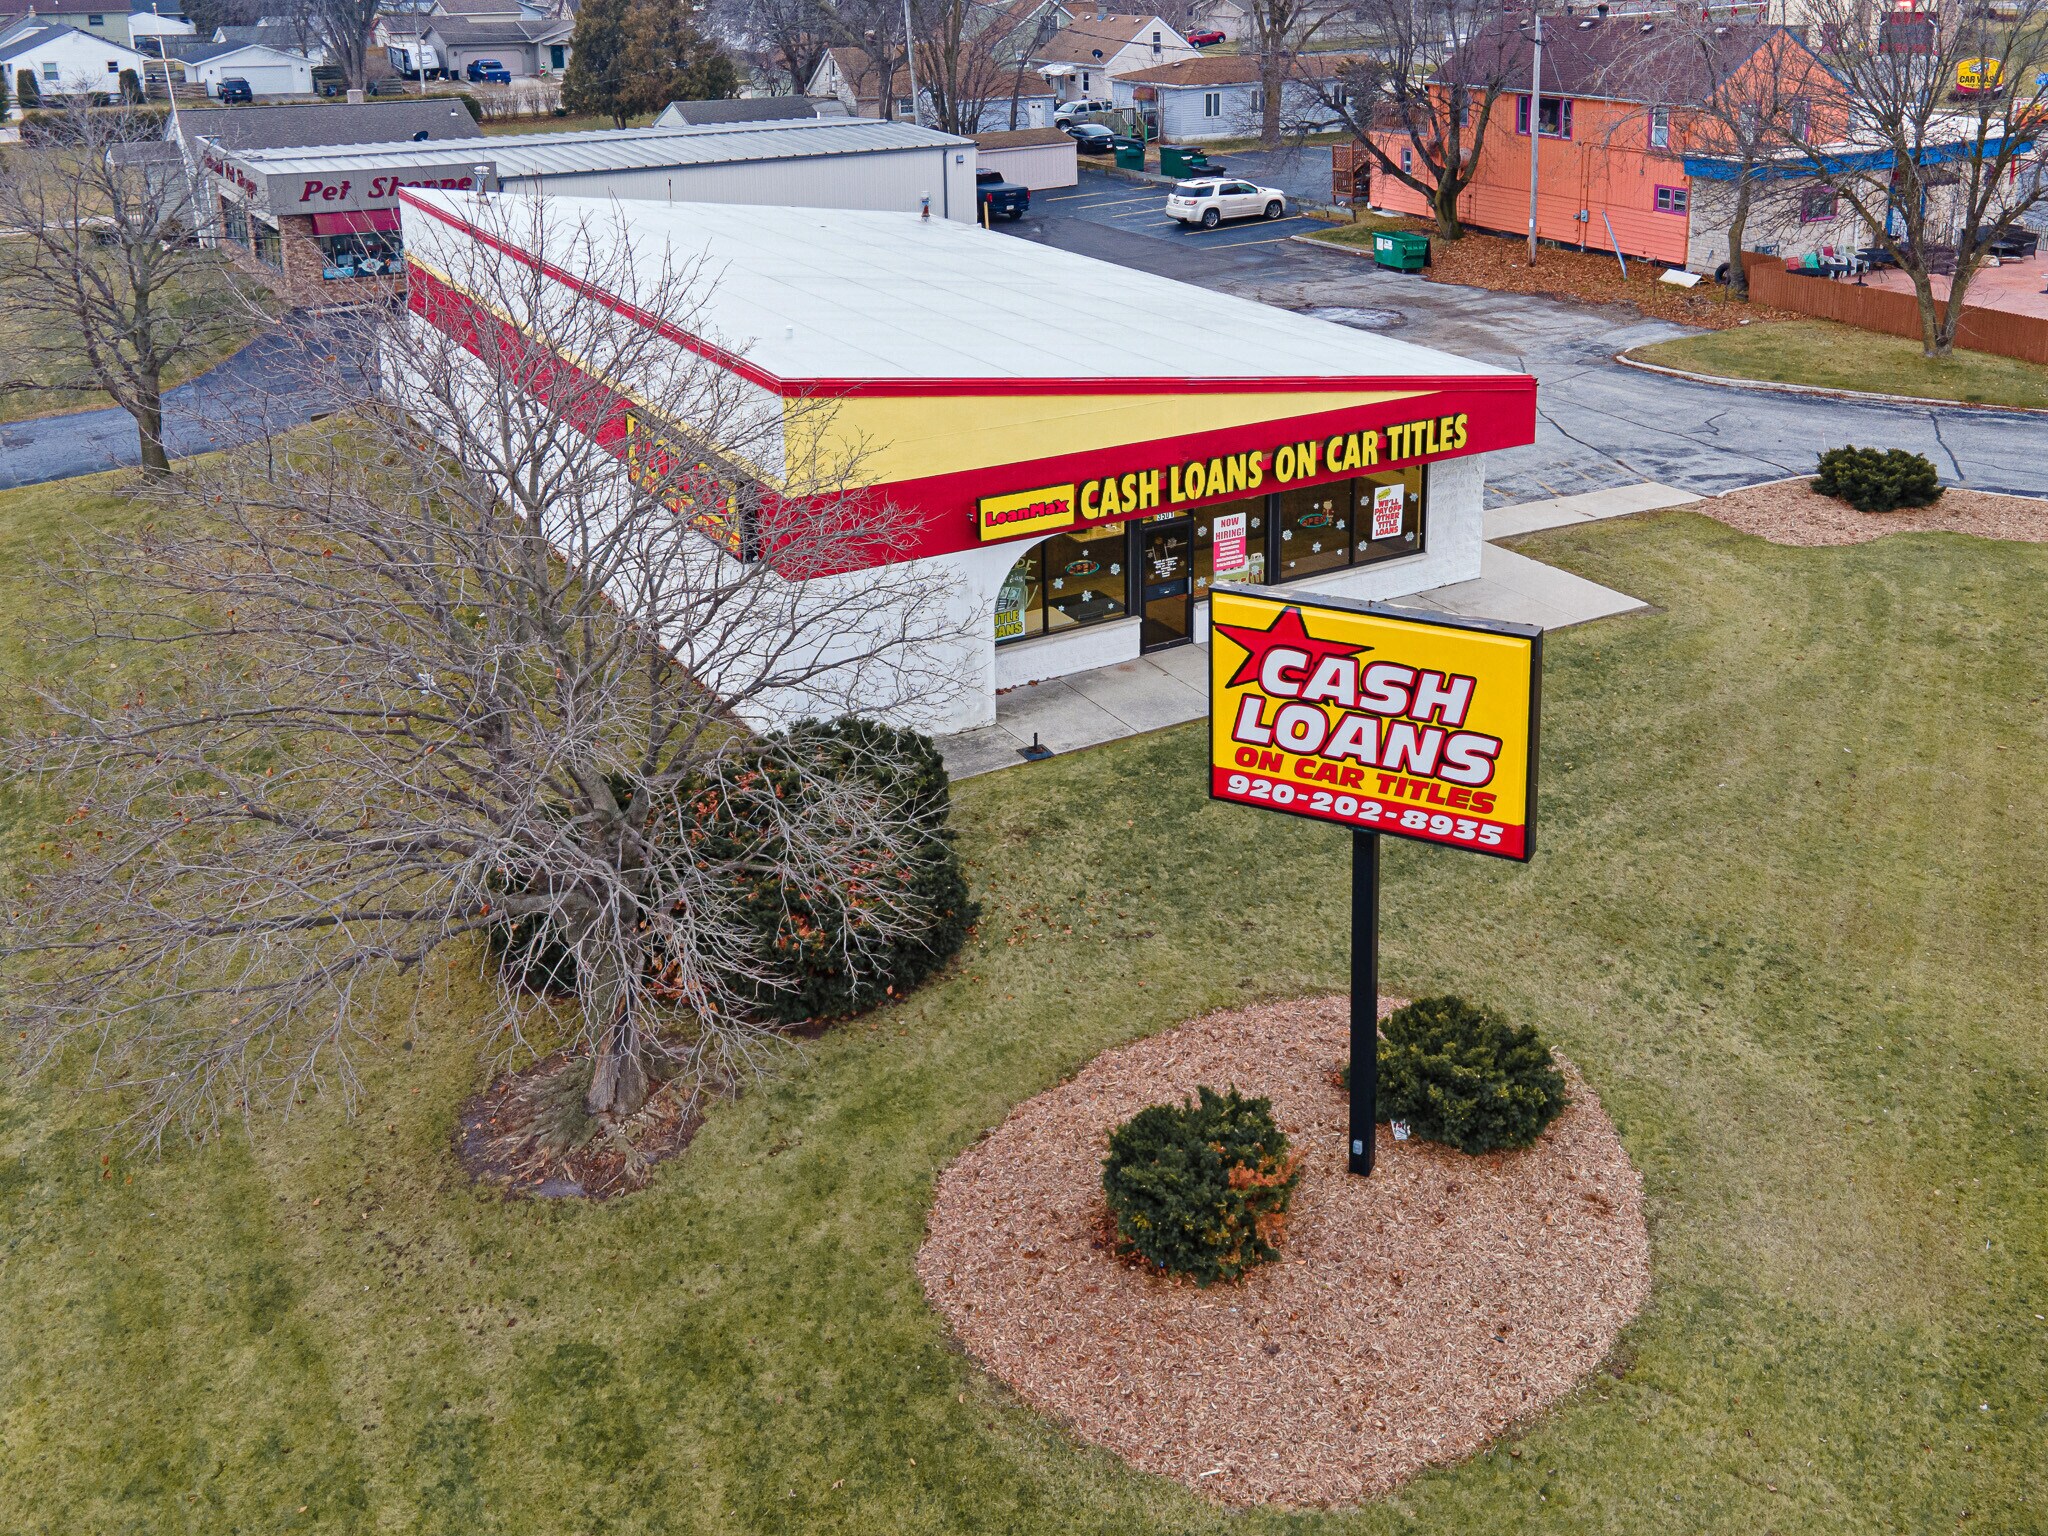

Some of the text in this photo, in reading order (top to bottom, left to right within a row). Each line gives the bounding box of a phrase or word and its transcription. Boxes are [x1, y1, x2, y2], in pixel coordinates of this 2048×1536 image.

[1959, 76, 1976, 84] CAR
[299, 179, 352, 202] Pet
[1079, 468, 1160, 520] CASH
[1167, 450, 1263, 503] LOANS
[1274, 440, 1317, 484] ON
[1325, 430, 1379, 473] CAR
[1384, 413, 1468, 462] TITLES
[1374, 505, 1402, 515] PAY OFF
[1375, 512, 1400, 522] OTHER
[1220, 517, 1239, 527] NOW
[1377, 520, 1397, 528] TITLE
[1215, 527, 1244, 541] HIRING!
[1375, 526, 1399, 536] LOANS
[995, 610, 1020, 626] ITLE
[995, 621, 1023, 639] ANS
[1258, 644, 1476, 728] CASH
[1232, 693, 1503, 787] LOANS
[1235, 747, 1497, 814] ON CAR TITLES
[1227, 774, 1504, 846] 920-202-8935
